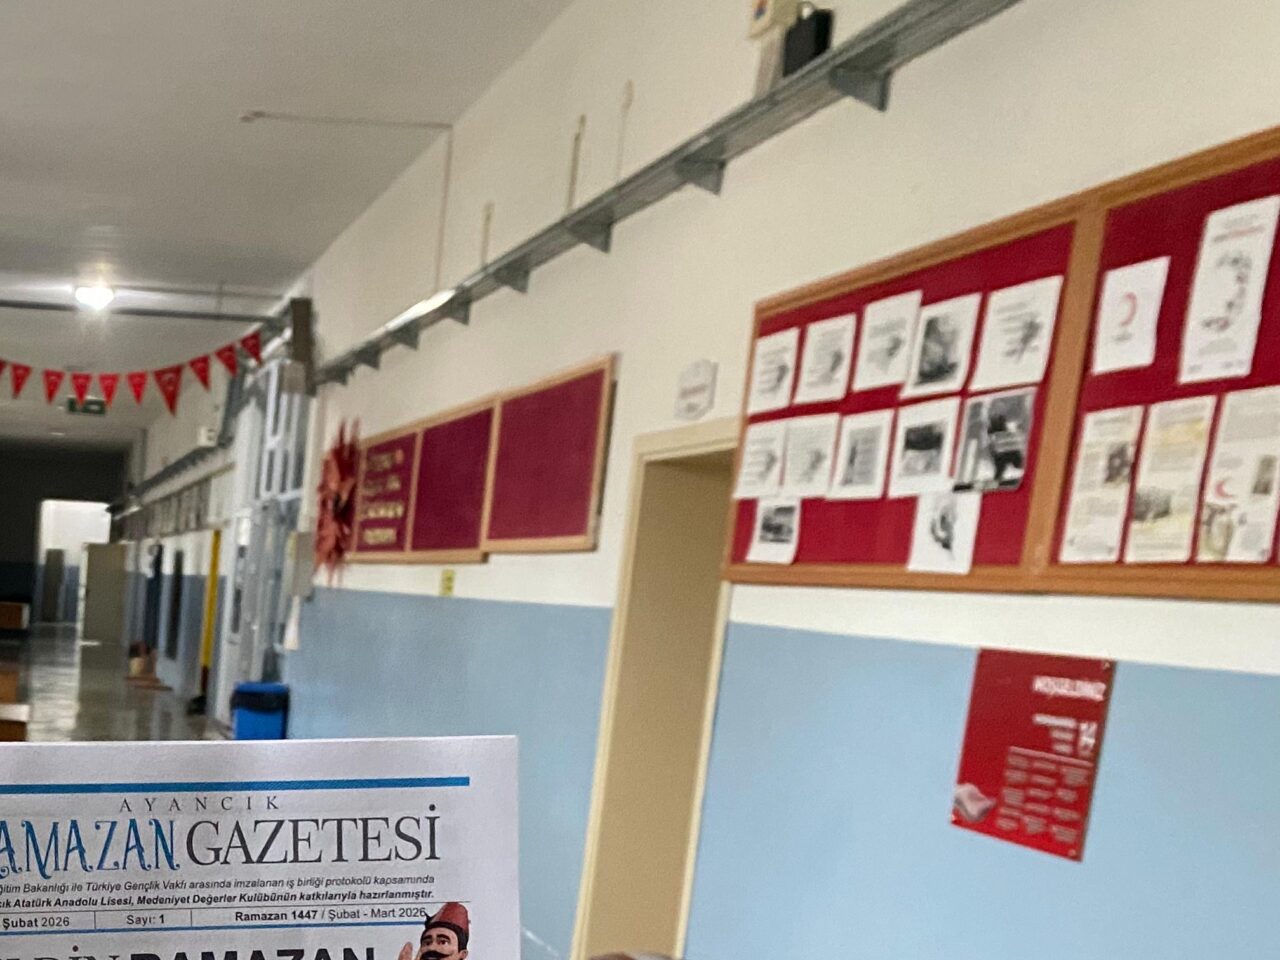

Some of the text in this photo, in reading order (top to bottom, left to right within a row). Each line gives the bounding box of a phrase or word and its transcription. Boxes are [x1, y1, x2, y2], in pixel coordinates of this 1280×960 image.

[120, 795, 280, 813] AYANCIK
[186, 803, 441, 866] GAZETESİ
[23, 883, 69, 894] Bakanlığı
[71, 883, 83, 892] ile
[86, 882, 121, 894] Türkiye
[124, 881, 160, 893] Gençlik
[163, 880, 187, 890] Vakfı
[189, 880, 232, 889] arasında
[234, 878, 284, 888] imzalanan
[297, 877, 324, 888] birliği
[325, 876, 372, 888] protokolü
[373, 874, 435, 887] kapsamında
[13, 898, 52, 908] Atatürk
[53, 897, 98, 907] Anadolu
[100, 896, 134, 906] Lisesi,
[137, 895, 190, 906] Medeniyet
[192, 894, 237, 906] Değerler
[239, 892, 297, 902] Kulübünün
[299, 891, 357, 902] katkılarıyla
[359, 889, 434, 900] hazırlanmıştır.
[2, 918, 38, 931] Şubat
[41, 916, 70, 927] 2026
[126, 914, 164, 927] Sayı: 1
[235, 911, 288, 921] Ramazan
[291, 910, 318, 920] 1447
[328, 909, 360, 922] Şubat
[370, 908, 396, 918] Mart
[398, 907, 426, 918] 2026
